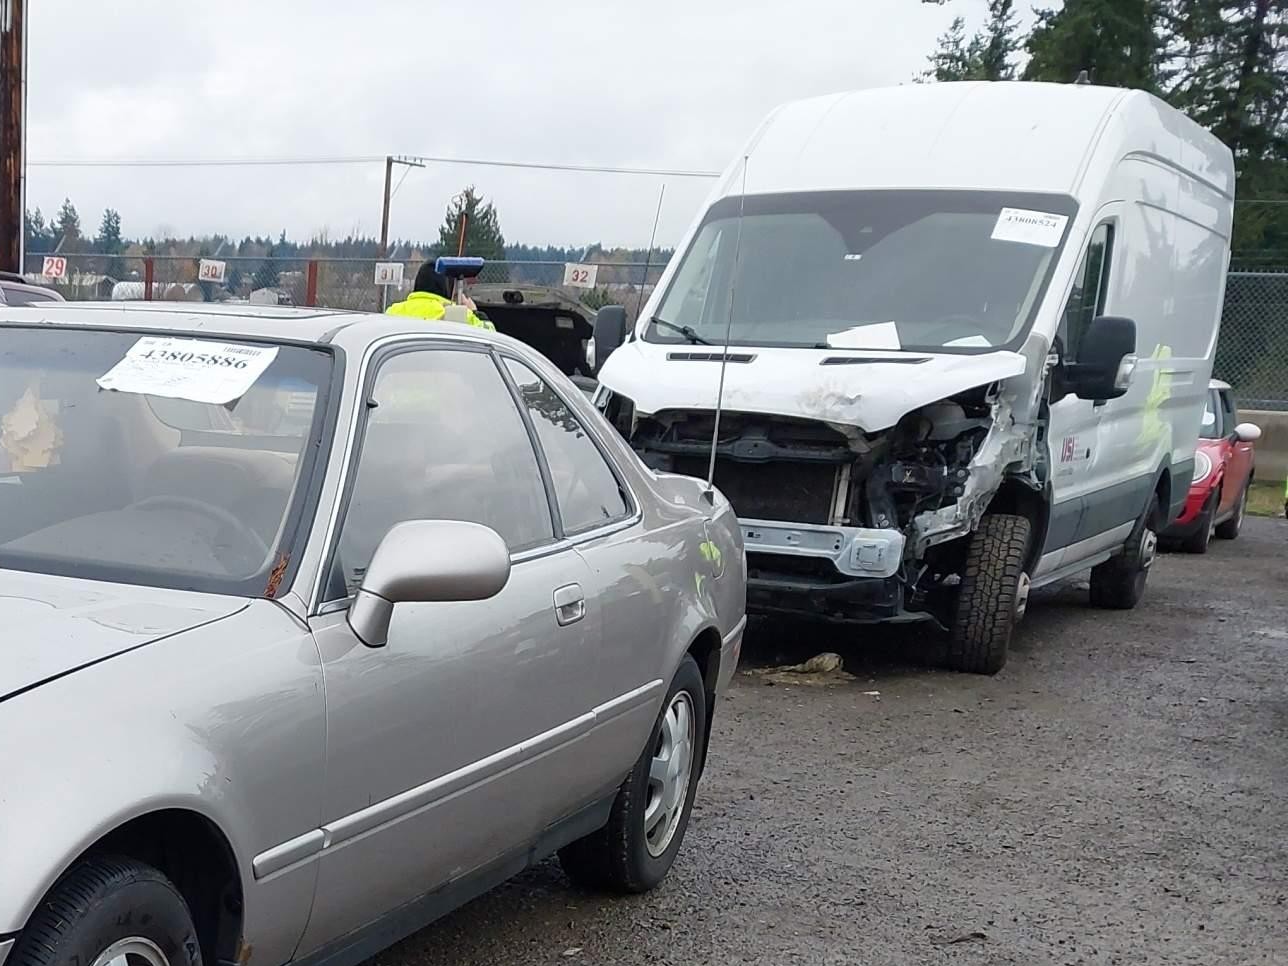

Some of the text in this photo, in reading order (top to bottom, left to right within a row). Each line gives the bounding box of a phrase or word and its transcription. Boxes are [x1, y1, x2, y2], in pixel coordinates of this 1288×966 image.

[45, 258, 64, 276] 29
[203, 264, 217, 278] 30
[381, 269, 394, 281] 31
[572, 270, 588, 283] 32
[140, 349, 249, 370] 43805886
